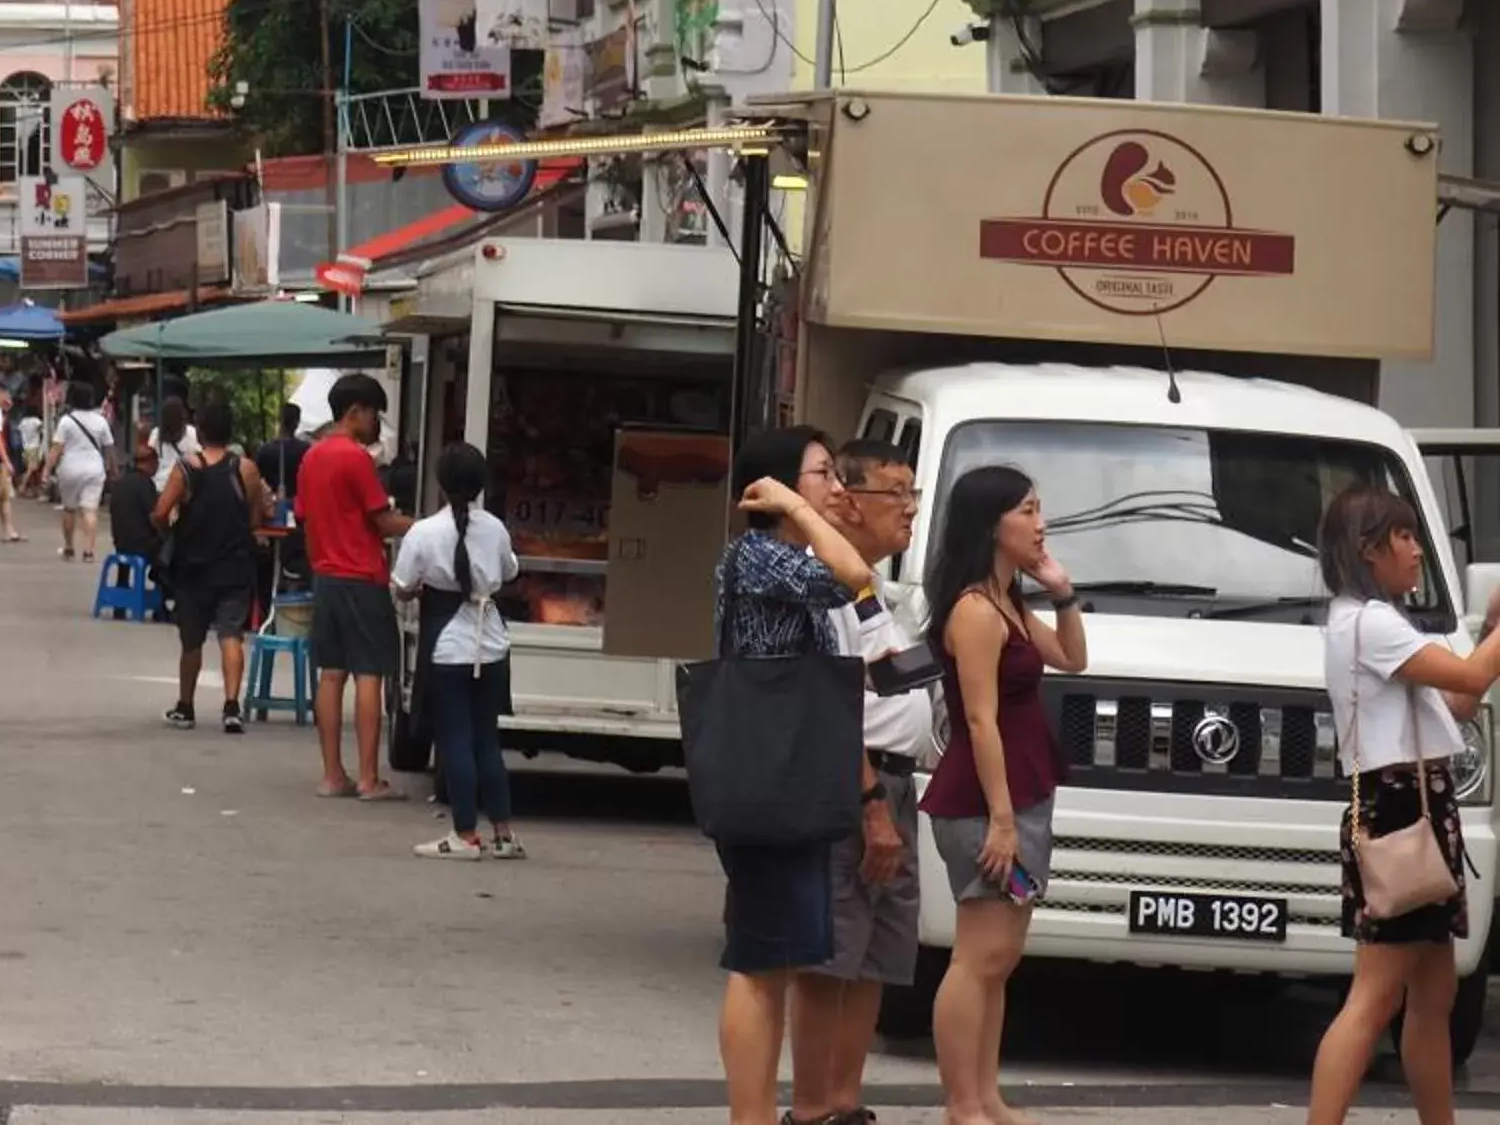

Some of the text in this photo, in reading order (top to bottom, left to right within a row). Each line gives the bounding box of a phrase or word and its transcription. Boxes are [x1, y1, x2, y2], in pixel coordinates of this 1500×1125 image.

[1022, 228, 1251, 265] COFFEE HAVEN
[1138, 897, 1278, 933] PMB 1392
